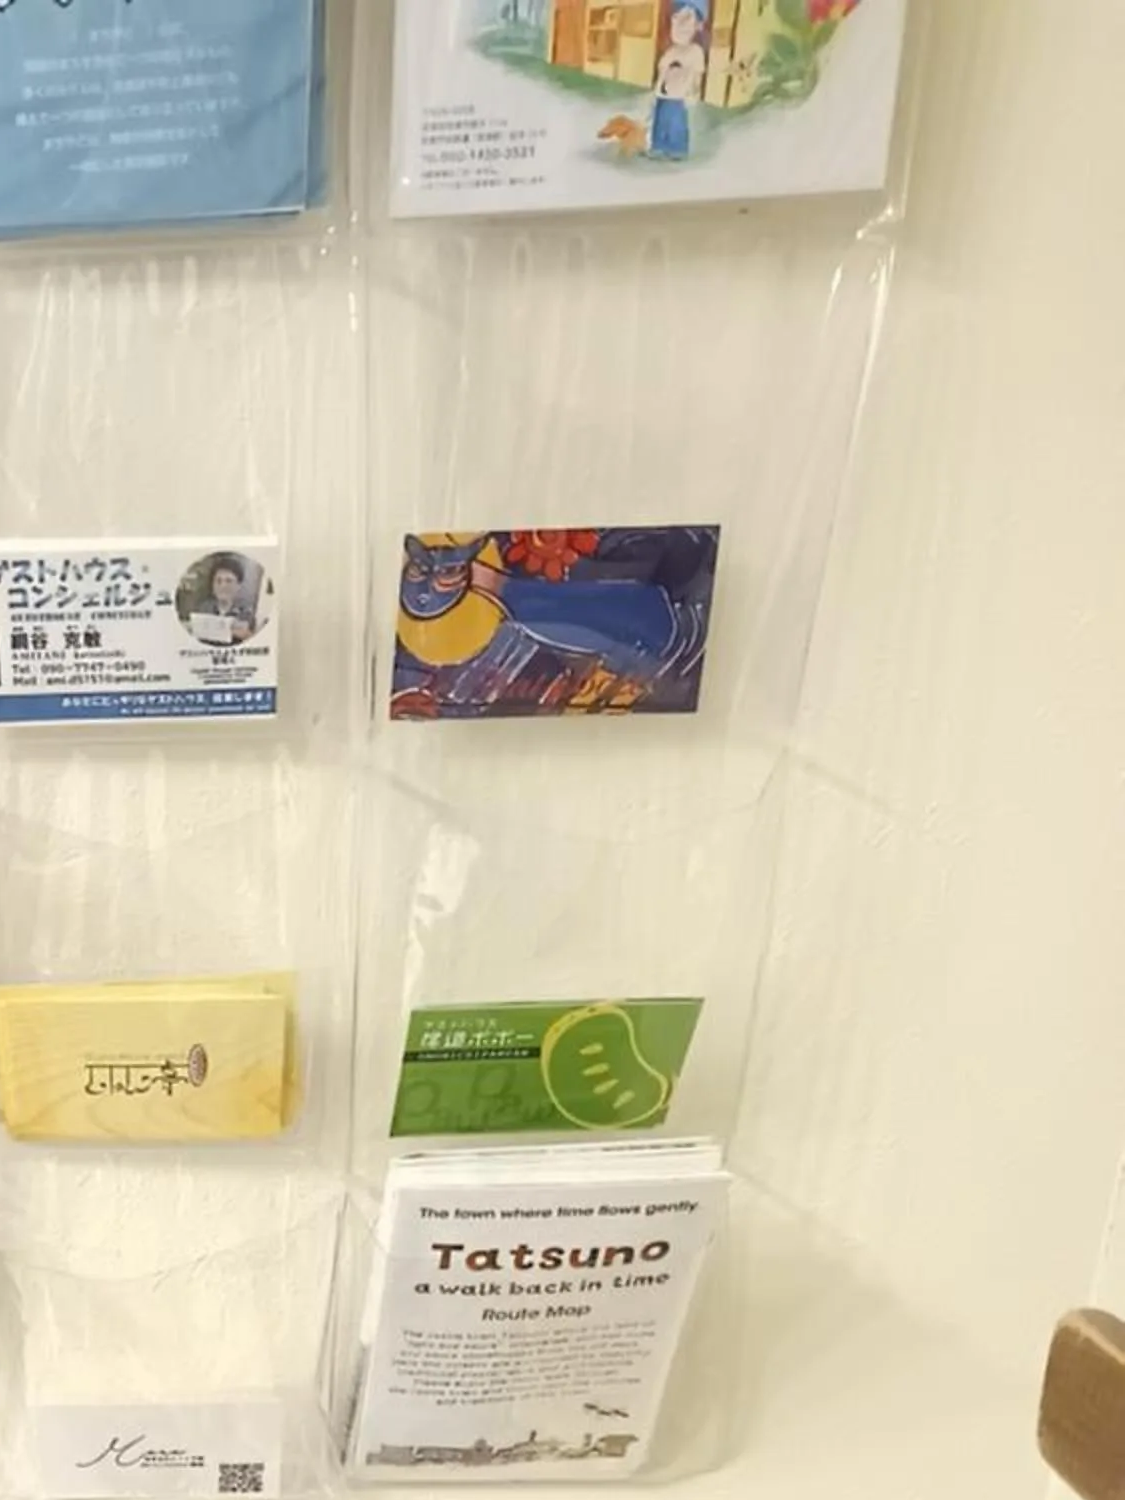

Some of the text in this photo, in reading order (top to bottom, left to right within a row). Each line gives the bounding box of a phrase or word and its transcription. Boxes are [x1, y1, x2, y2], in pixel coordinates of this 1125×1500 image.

[419, 1200, 699, 1220] The town where time flows gently
[431, 1239, 672, 1272] Tatsuno
[414, 1271, 671, 1297] a walk back in time
[481, 1303, 592, 1322] Route Map
